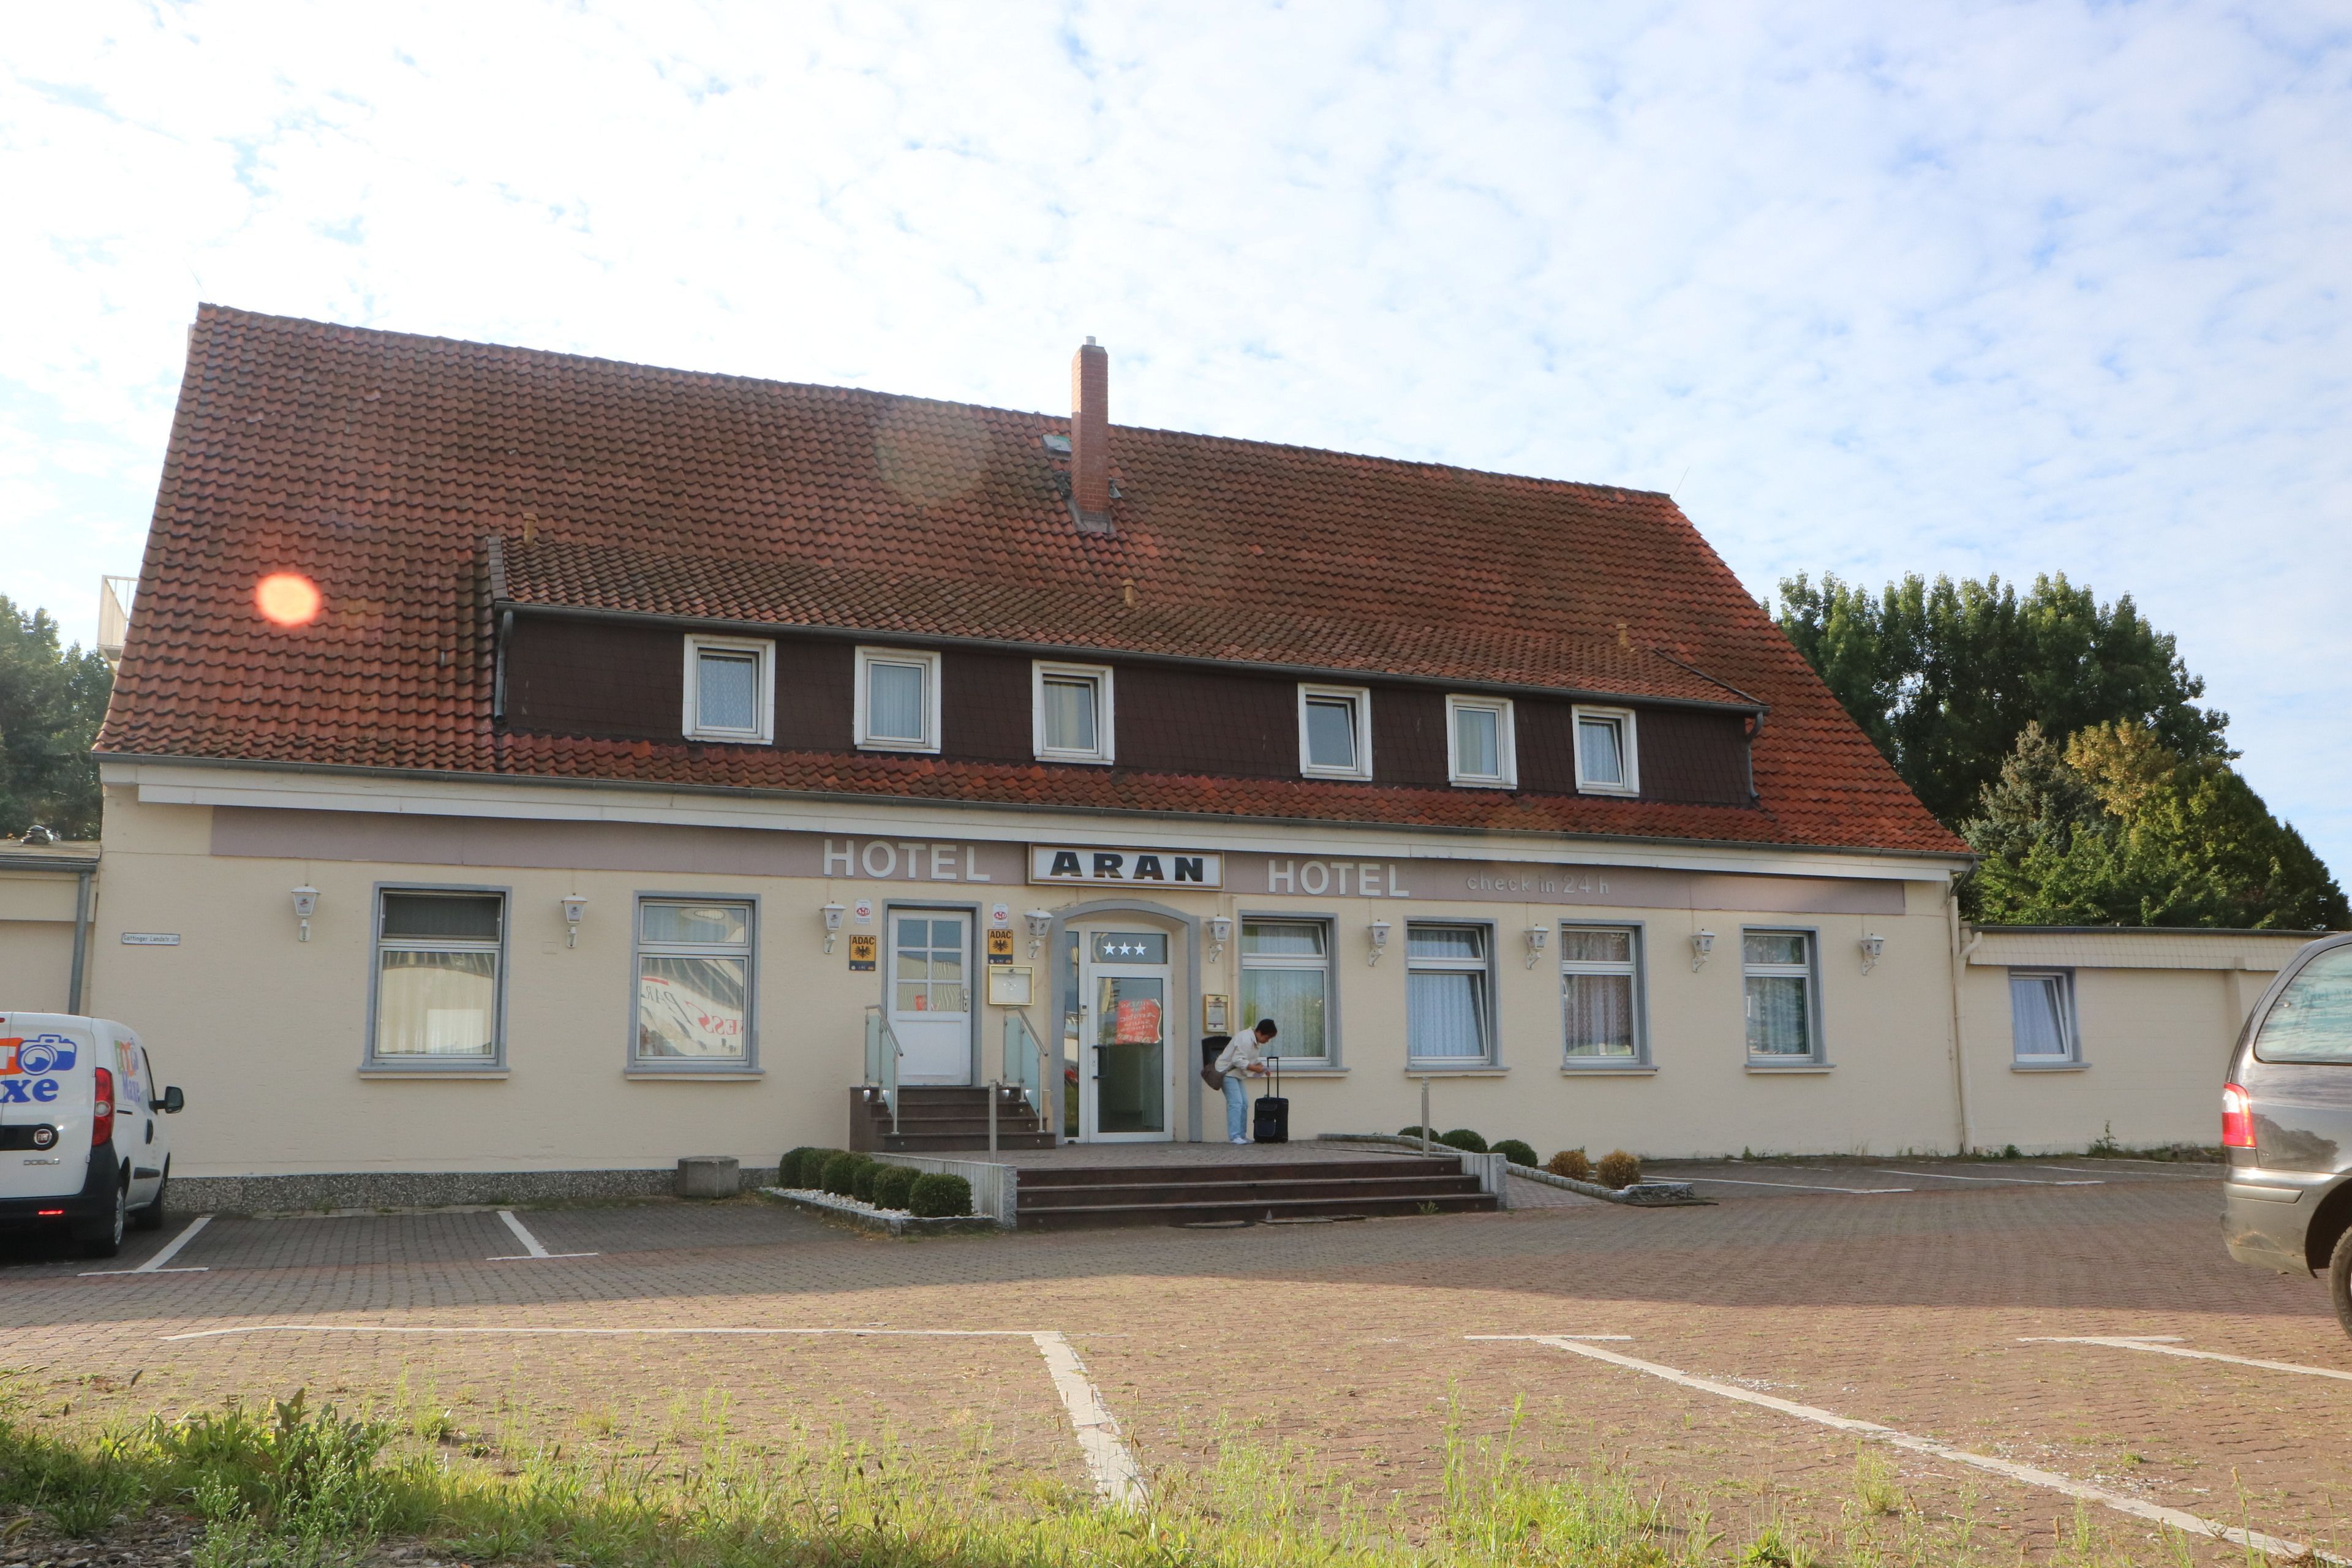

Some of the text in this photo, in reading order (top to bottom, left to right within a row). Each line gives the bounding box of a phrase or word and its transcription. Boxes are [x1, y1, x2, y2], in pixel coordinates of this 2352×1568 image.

[823, 839, 990, 882] HOTEL
[1050, 851, 1204, 882] ARAN
[1268, 860, 1409, 897] HOTEL
[1466, 870, 1609, 894] check in 24 h
[852, 937, 875, 945] ADAC
[990, 930, 1012, 939] ADAC
